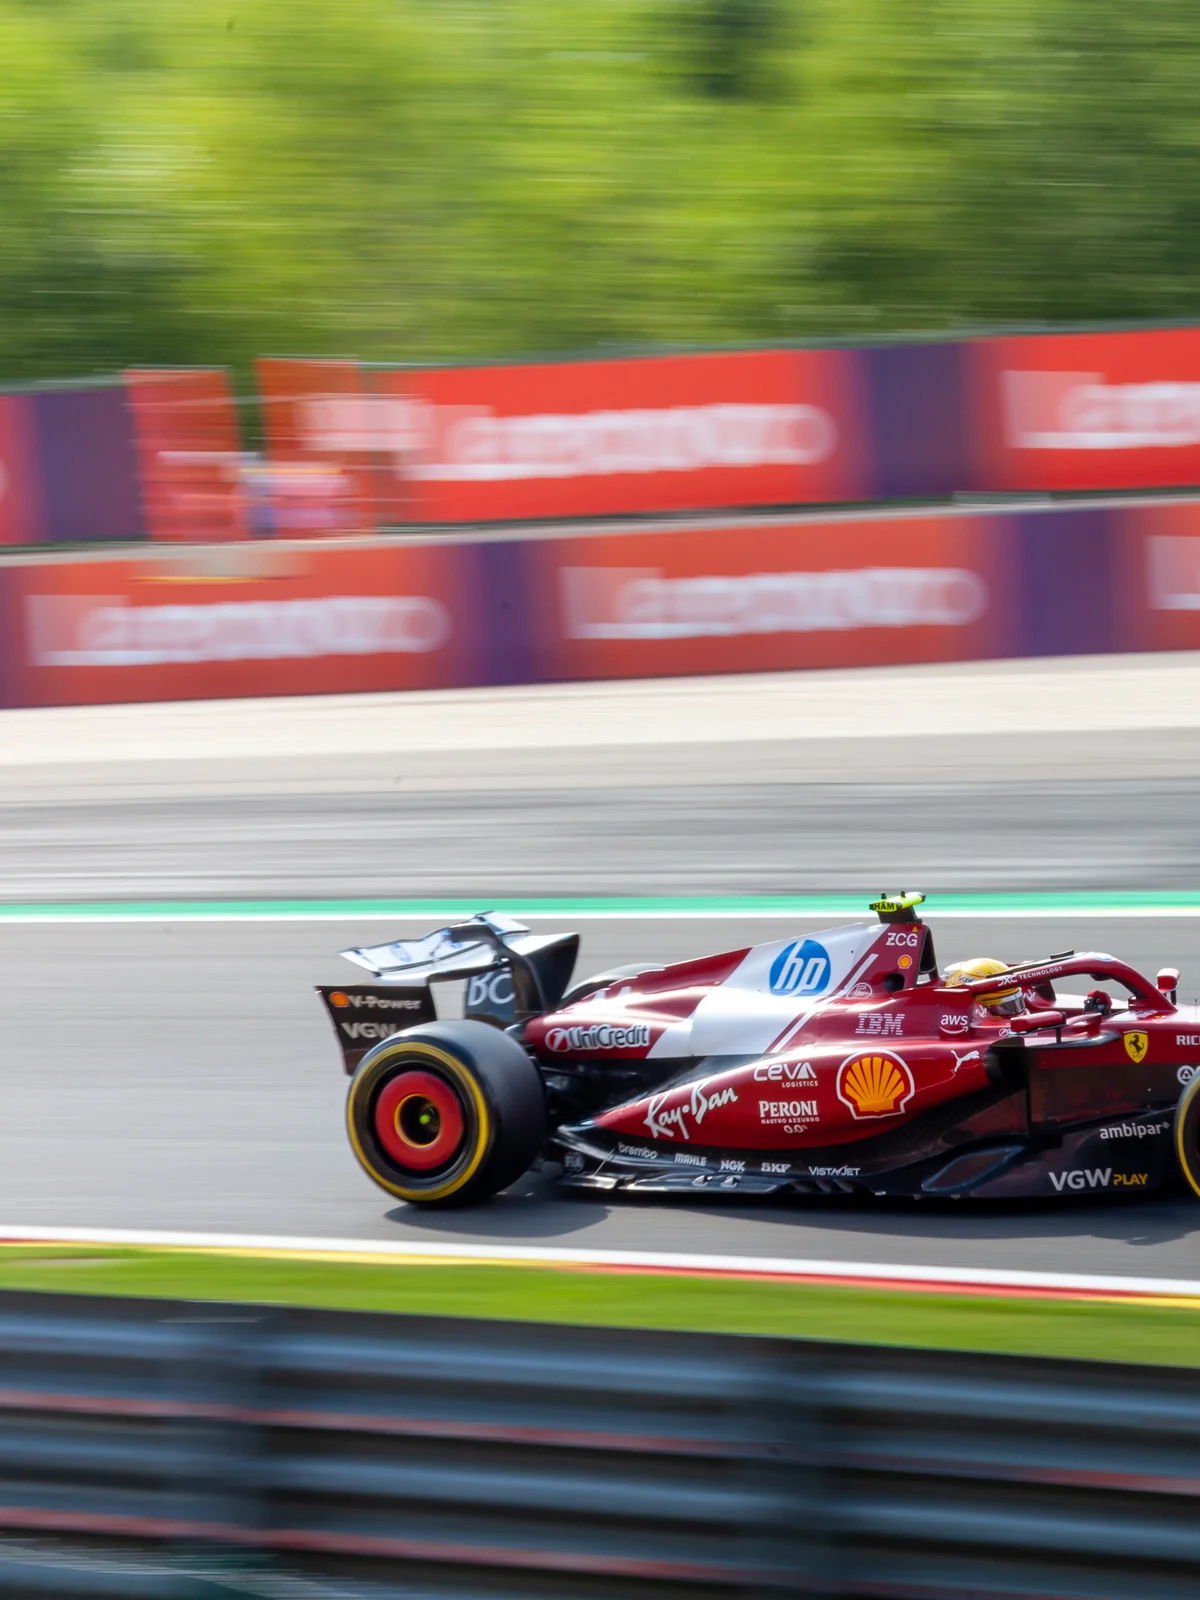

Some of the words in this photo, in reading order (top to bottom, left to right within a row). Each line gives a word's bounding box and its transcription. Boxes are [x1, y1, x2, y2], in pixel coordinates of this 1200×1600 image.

[874, 901, 896, 911] HAM
[886, 932, 918, 947] ZCG
[772, 939, 828, 997] hp
[1018, 966, 1063, 980] TECHNOLOGY
[347, 995, 422, 1009] V-Power
[855, 1013, 905, 1036] IBM
[940, 1014, 968, 1026] aws
[569, 1024, 650, 1050] UniCredit
[758, 1100, 818, 1117] PERONI
[1099, 1122, 1162, 1139] ambipar
[618, 1141, 658, 1160] brembo
[674, 1152, 707, 1167] MAHLE
[720, 1160, 746, 1172] NGK
[761, 1162, 791, 1173] SKF
[1048, 1168, 1112, 1192] VGW
[1112, 1173, 1149, 1186] PLAY
